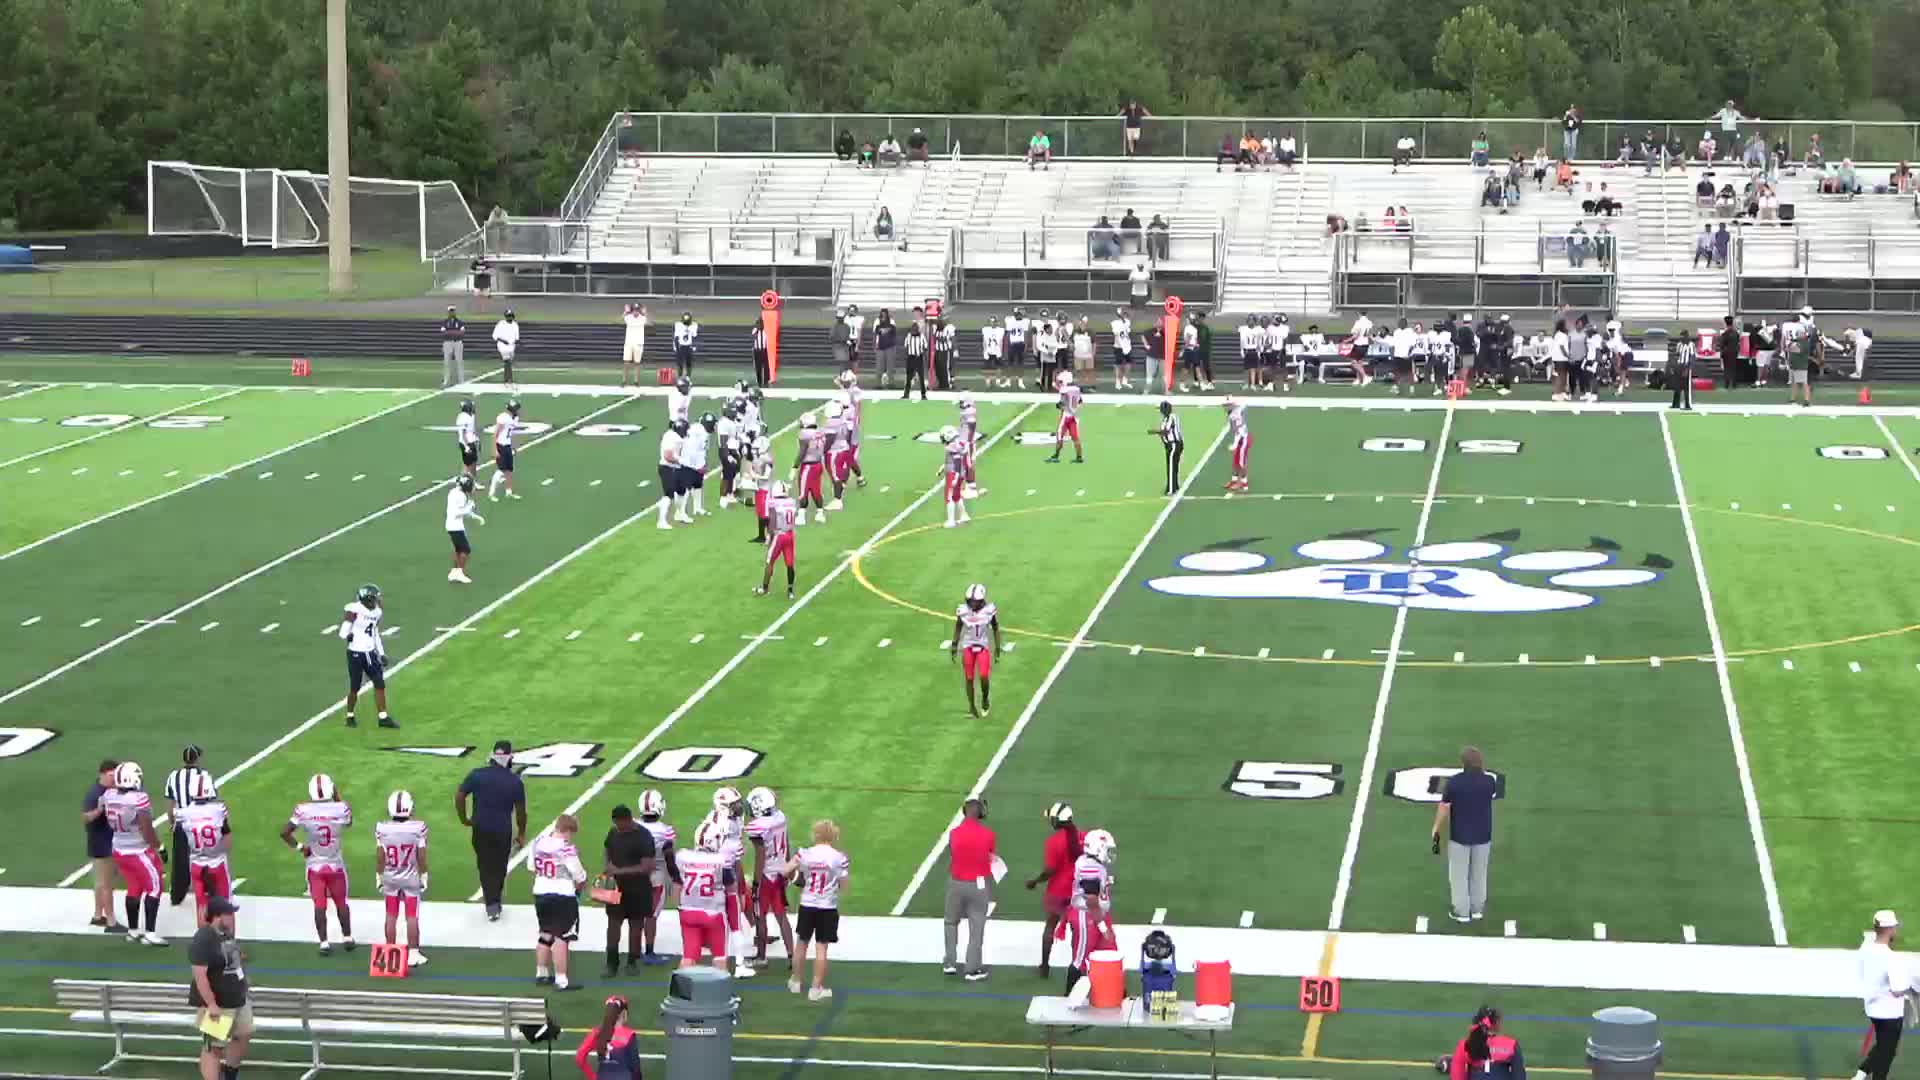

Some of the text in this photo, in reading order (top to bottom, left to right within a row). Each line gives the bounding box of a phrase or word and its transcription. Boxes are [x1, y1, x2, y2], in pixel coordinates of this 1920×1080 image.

[364, 622, 374, 637] 4
[191, 825, 216, 848] 19
[318, 826, 332, 847] 3
[684, 872, 715, 897] 72
[810, 872, 828, 895] 11
[373, 947, 401, 974] 40
[1303, 979, 1334, 1008] 50
